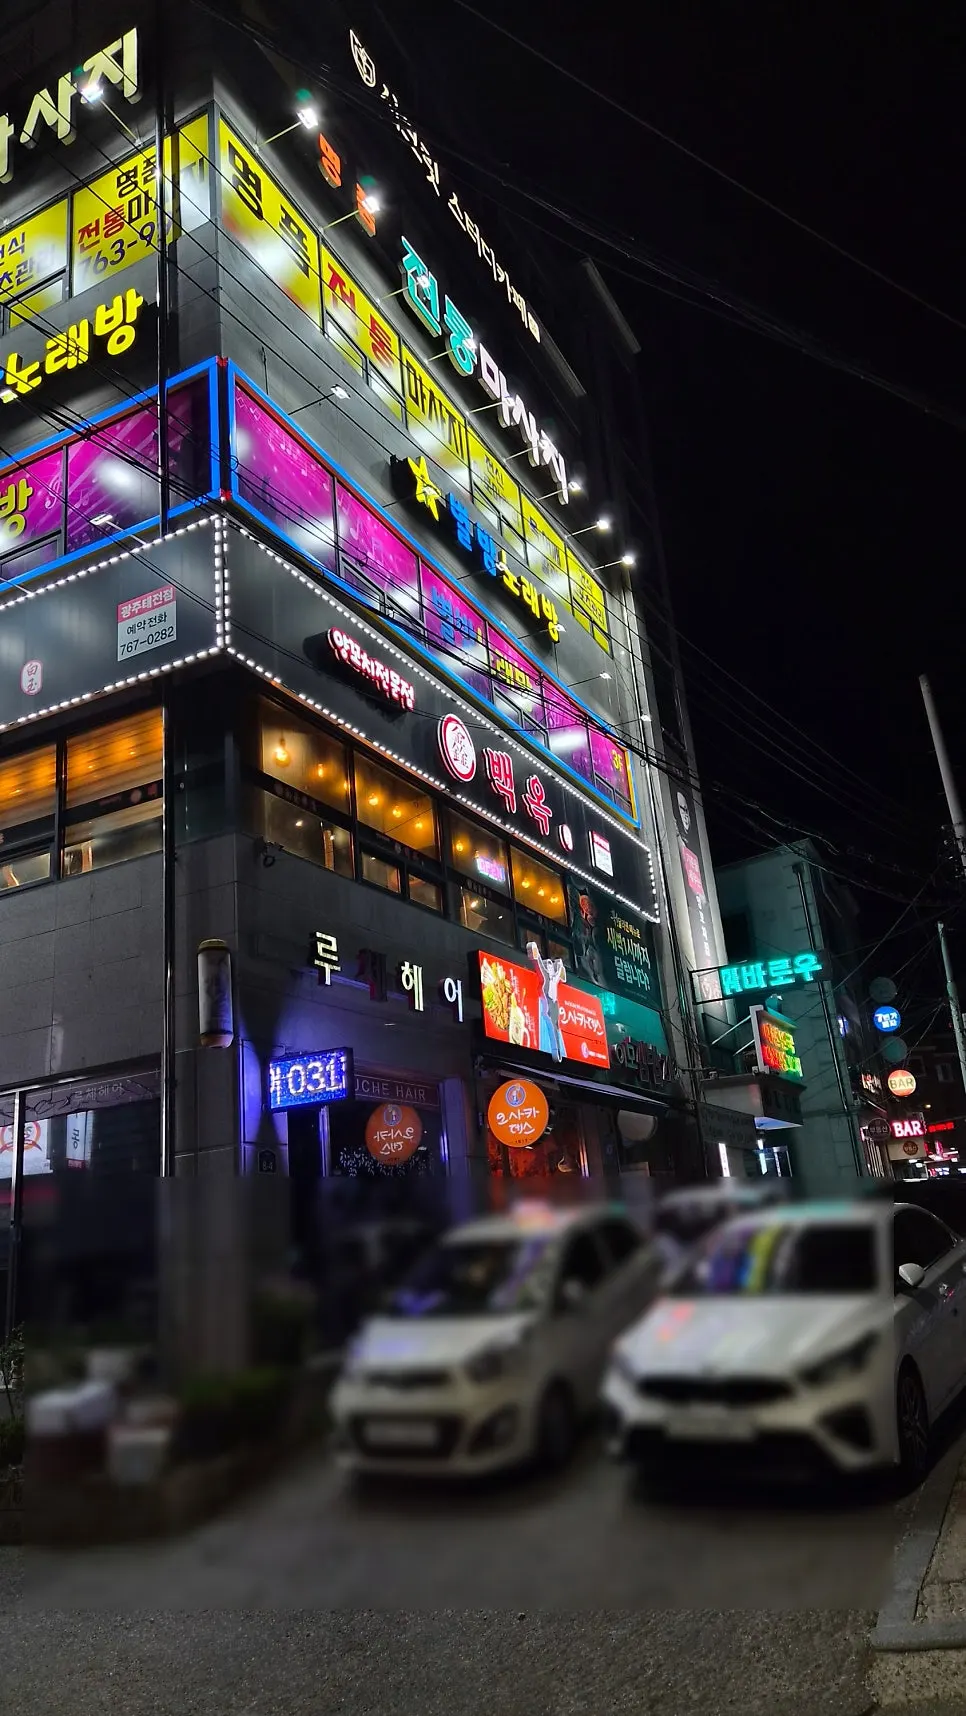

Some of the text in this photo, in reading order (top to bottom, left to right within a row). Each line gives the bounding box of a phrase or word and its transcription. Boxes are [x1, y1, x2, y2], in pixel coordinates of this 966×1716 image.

[447, 191, 529, 329] 스터디카페
[399, 235, 569, 505] 전통마사지
[405, 350, 467, 461] 마사지
[119, 587, 175, 619] 광주태전점
[118, 625, 174, 656] 767-0282
[329, 628, 416, 712] 양꼬치전문점
[484, 748, 553, 838] 백옥
[313, 930, 465, 1024] 루헤어
[395, 1084, 426, 1103] HAIR
[889, 1076, 915, 1091] BAR
[496, 1106, 541, 1126] 오사카
[892, 1119, 925, 1138] BAR
